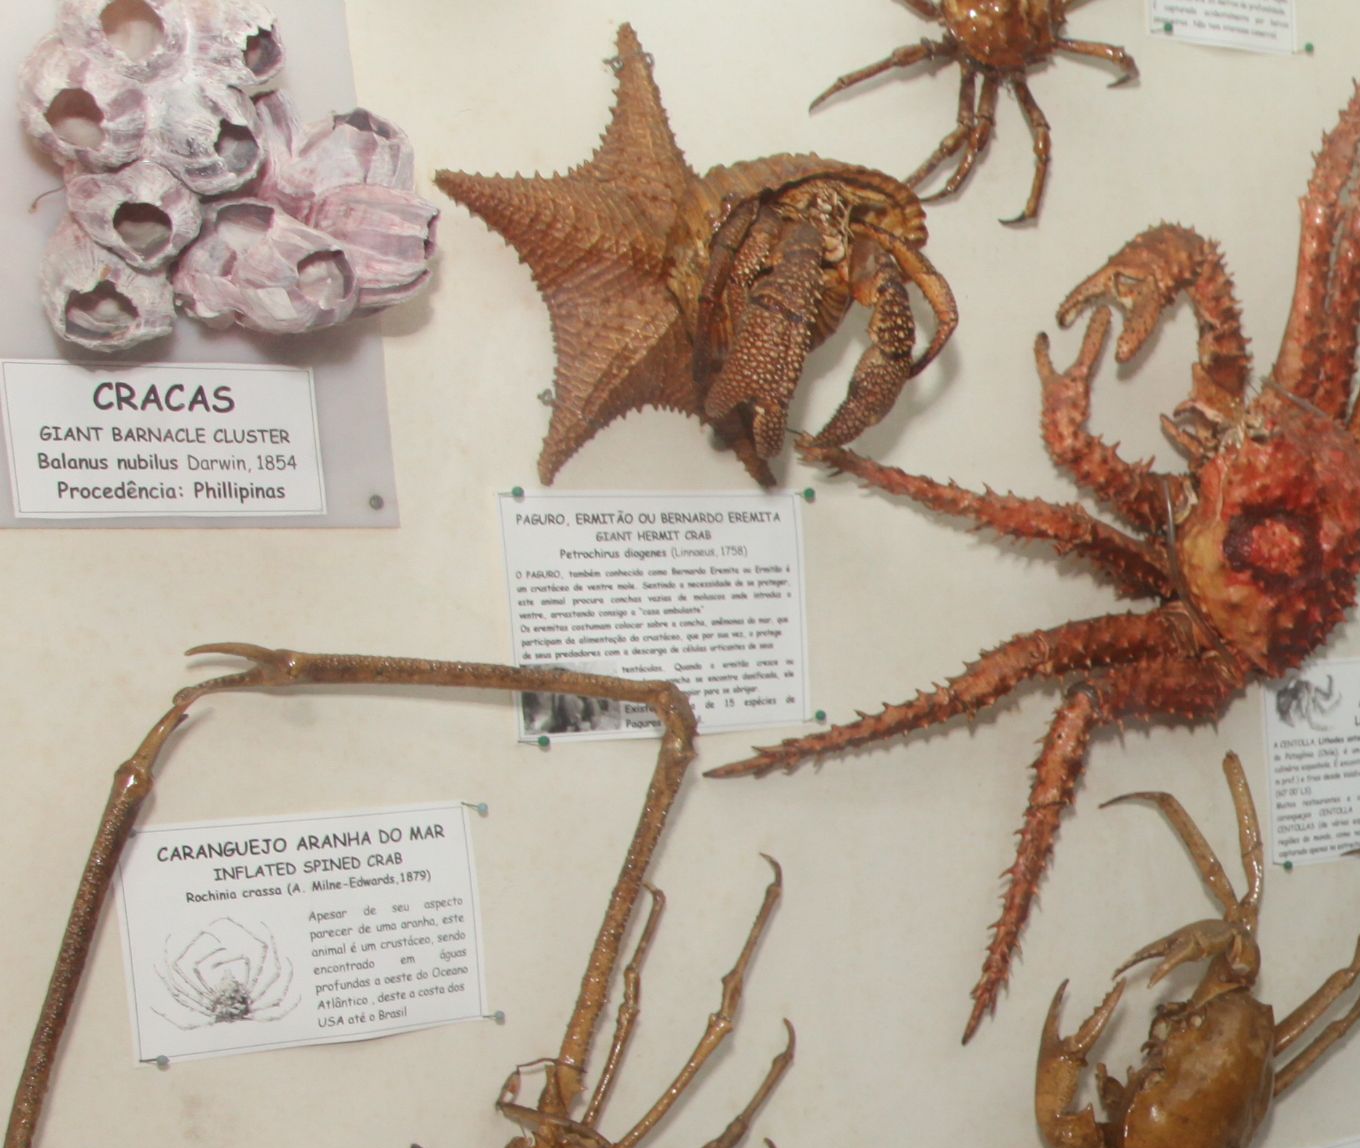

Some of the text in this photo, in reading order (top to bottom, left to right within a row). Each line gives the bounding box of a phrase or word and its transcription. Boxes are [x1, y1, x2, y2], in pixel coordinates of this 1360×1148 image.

[92, 381, 234, 413] CRACAS
[39, 425, 290, 444] GIANT BARNACLE CLUSTER
[37, 452, 296, 472] Balanus nubilus Darwin, 1854
[57, 480, 285, 504] Procedência: Phillipinas
[515, 509, 780, 526] PAGURO, ERMITÃO OU BERNARDO EREMITA
[595, 529, 711, 542] GIANT HERMIT CRAB
[559, 548, 620, 559] Petrochirus
[623, 547, 666, 560] diogenes
[720, 545, 747, 555] 1758)
[156, 823, 444, 862] CARANGUEJO ARANHA DO MAR
[212, 851, 402, 881] INFLATED SPINED CRAB
[185, 889, 236, 903] Rochinia
[242, 887, 282, 898] crassa
[308, 896, 462, 923] Apesar de seu aspecto
[309, 913, 463, 942] parecer de uma aranha, este
[311, 929, 465, 957] animal é um crustáceo, sendo
[313, 948, 466, 975] encontrado em águas
[315, 966, 468, 994] profundas a oeste do Oceano
[316, 996, 368, 1009] Atlântico
[377, 991, 406, 1003] deste
[408, 990, 415, 998] a
[417, 985, 445, 997] costa
[447, 982, 464, 992] dos
[318, 1006, 407, 1027] USA até o Brasil
